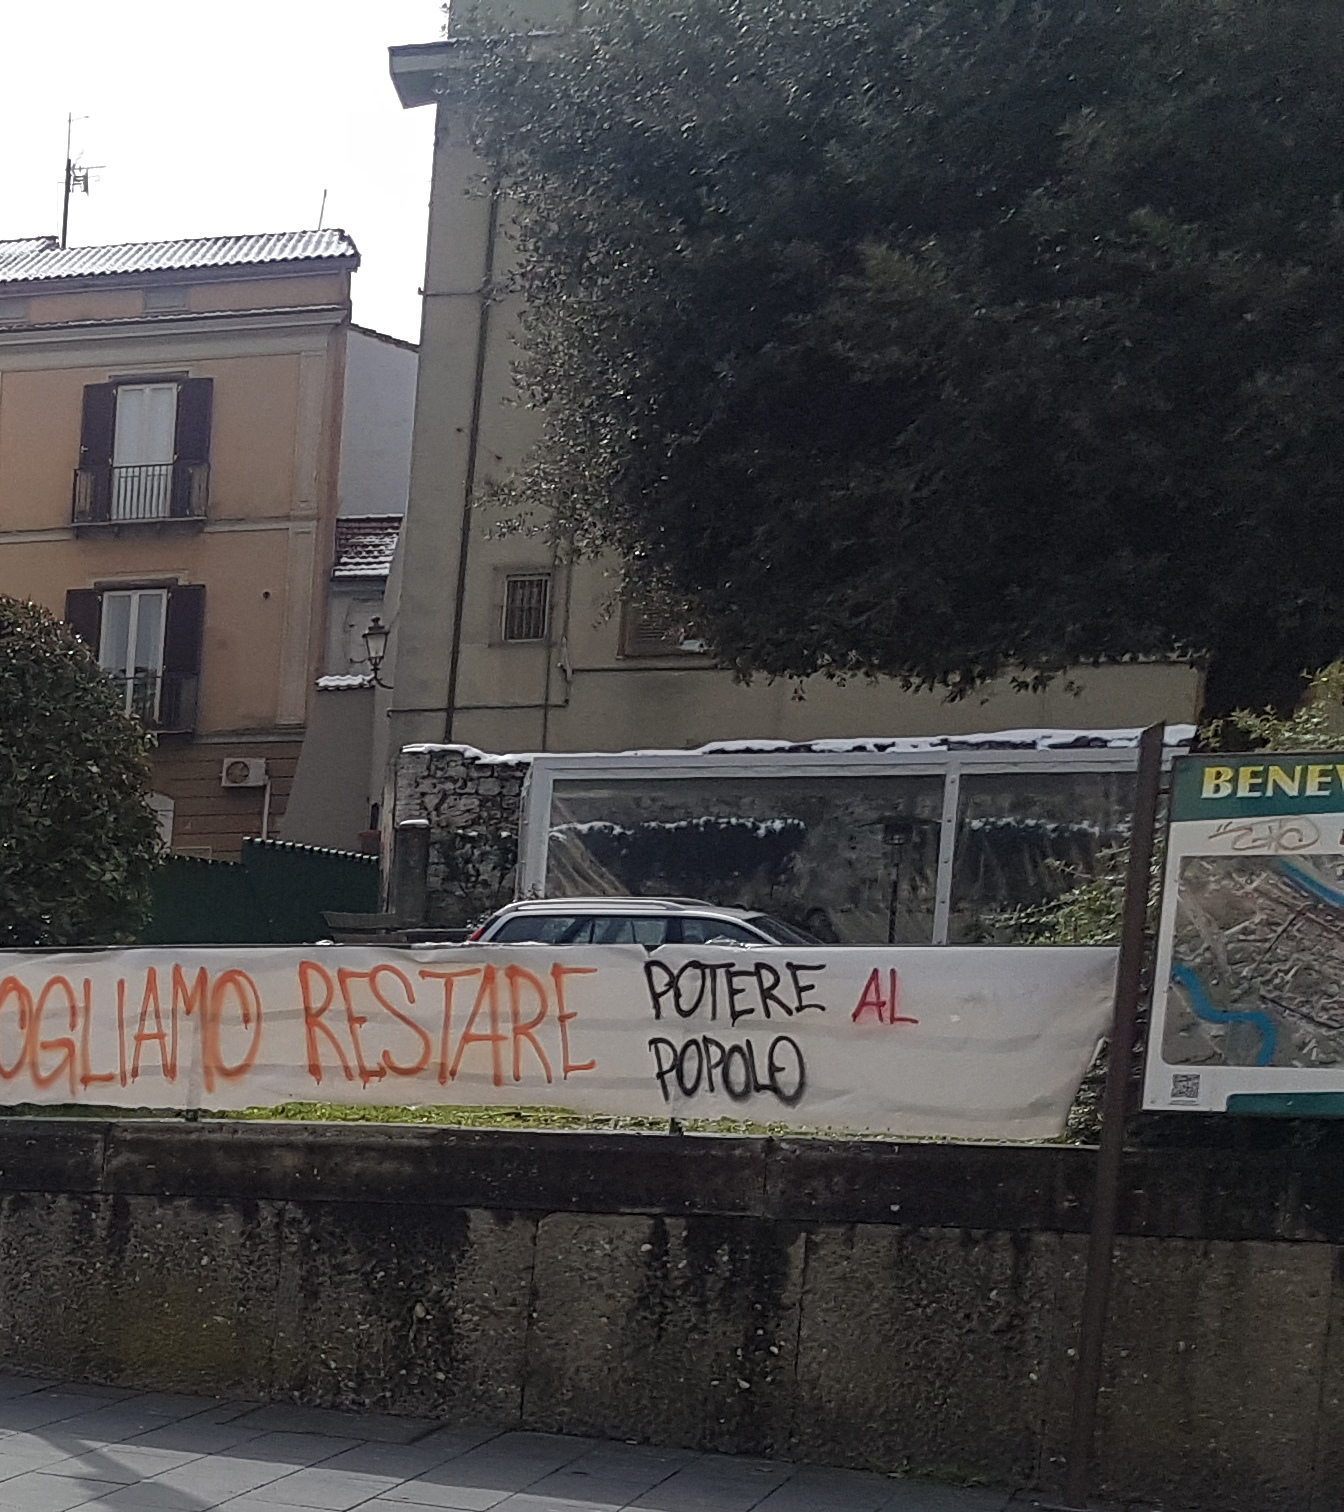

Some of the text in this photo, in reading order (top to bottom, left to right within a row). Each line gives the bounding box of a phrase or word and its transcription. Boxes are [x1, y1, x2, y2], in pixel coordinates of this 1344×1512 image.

[298, 960, 598, 1088] RESTARE
[644, 960, 919, 1027] POTERE AL
[648, 1034, 806, 1107] POPOLO
